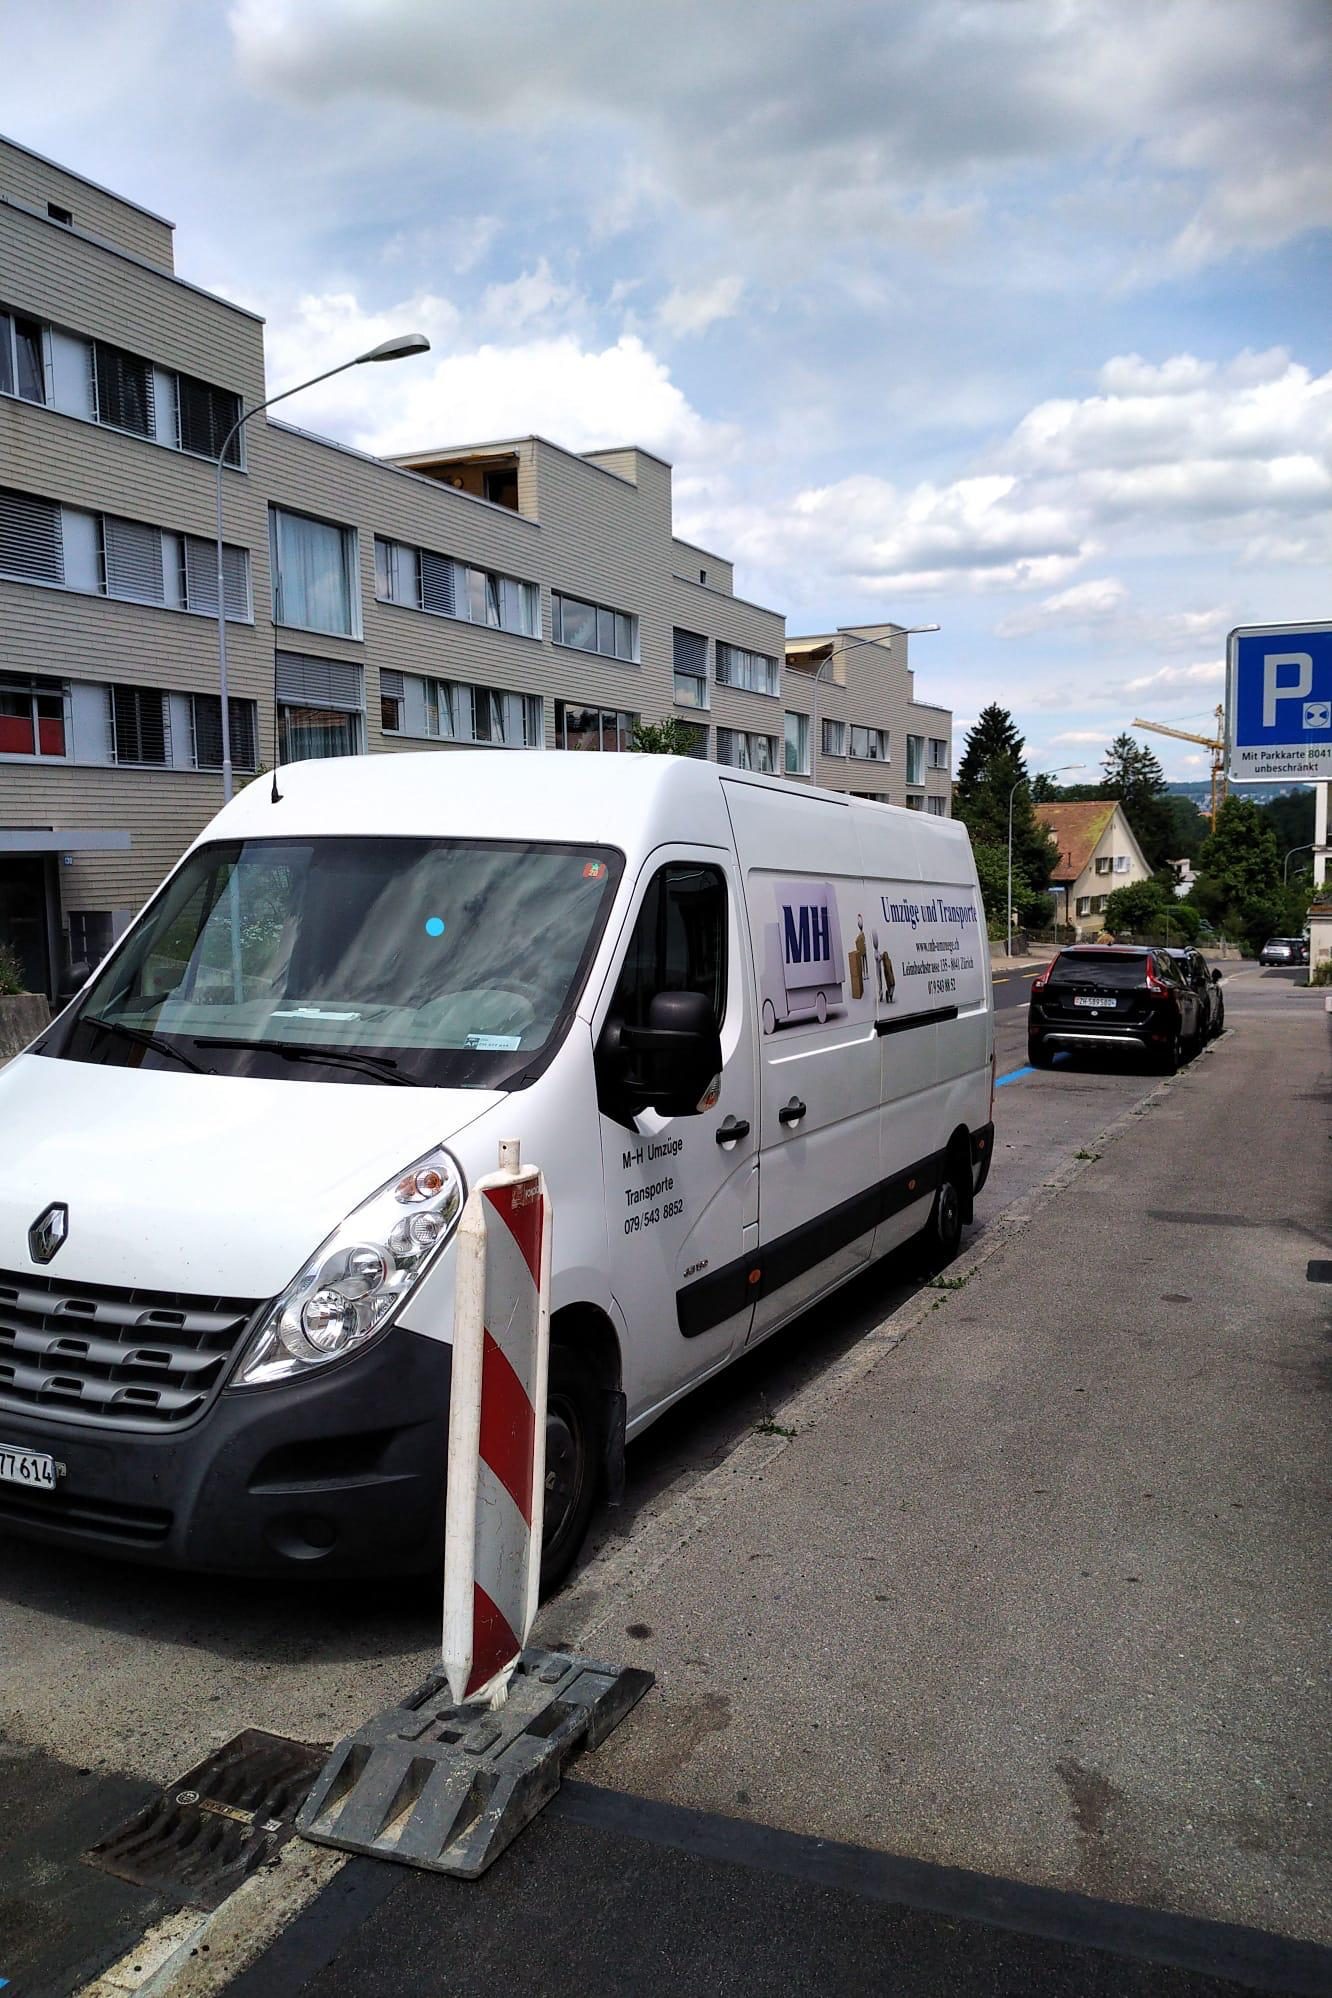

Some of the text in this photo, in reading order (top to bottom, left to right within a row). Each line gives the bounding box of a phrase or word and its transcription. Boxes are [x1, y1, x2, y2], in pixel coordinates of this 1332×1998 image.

[1263, 652, 1313, 727] P
[1242, 749, 1332, 760] Mit Parkkarte 8041
[1254, 762, 1319, 773] unbeschränkt
[880, 896, 978, 930] Umzüge und Transporte
[783, 905, 830, 964] MH
[622, 1136, 683, 1169] M-H Umzüge
[625, 1176, 674, 1207] Transporte
[624, 1198, 683, 1235] 079/543 8852
